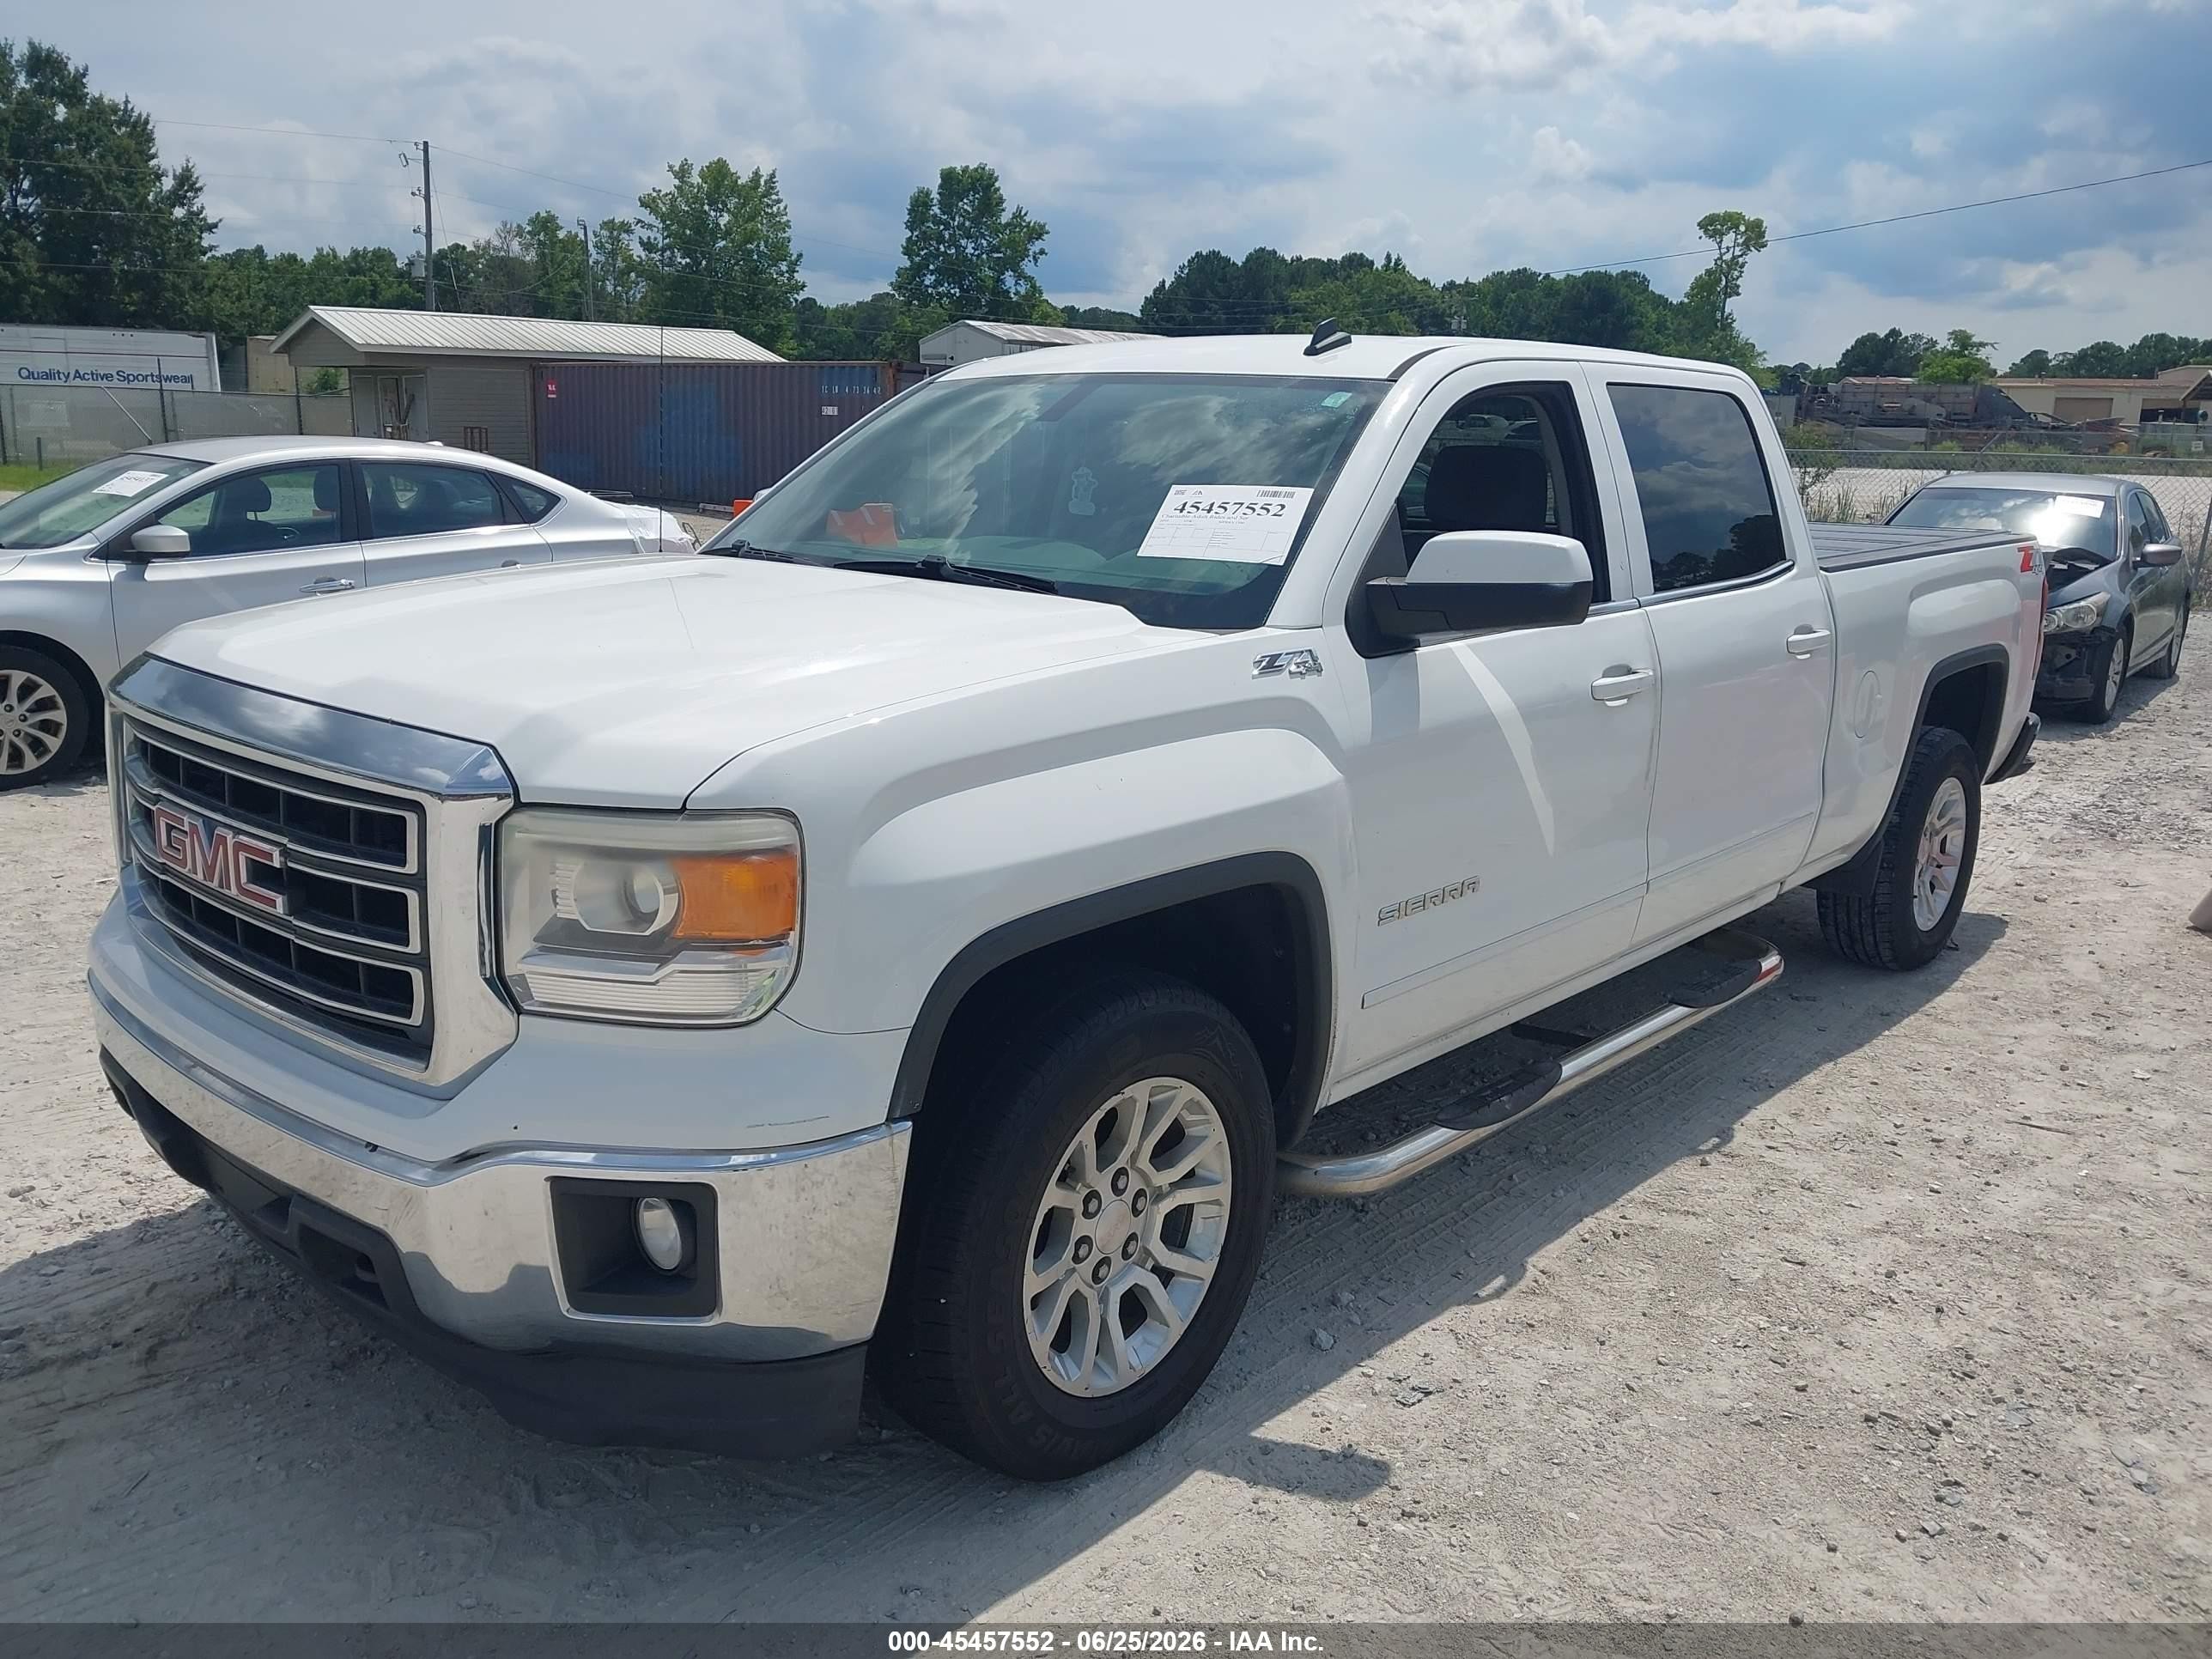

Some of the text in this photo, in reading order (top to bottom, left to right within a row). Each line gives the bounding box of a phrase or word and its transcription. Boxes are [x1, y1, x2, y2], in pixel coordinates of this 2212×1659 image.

[17, 367, 71, 383] Quality
[72, 368, 114, 382] Active
[1173, 501, 1286, 517] 45457552
[154, 800, 289, 915] GMC
[1376, 874, 1482, 927] SIERRA
